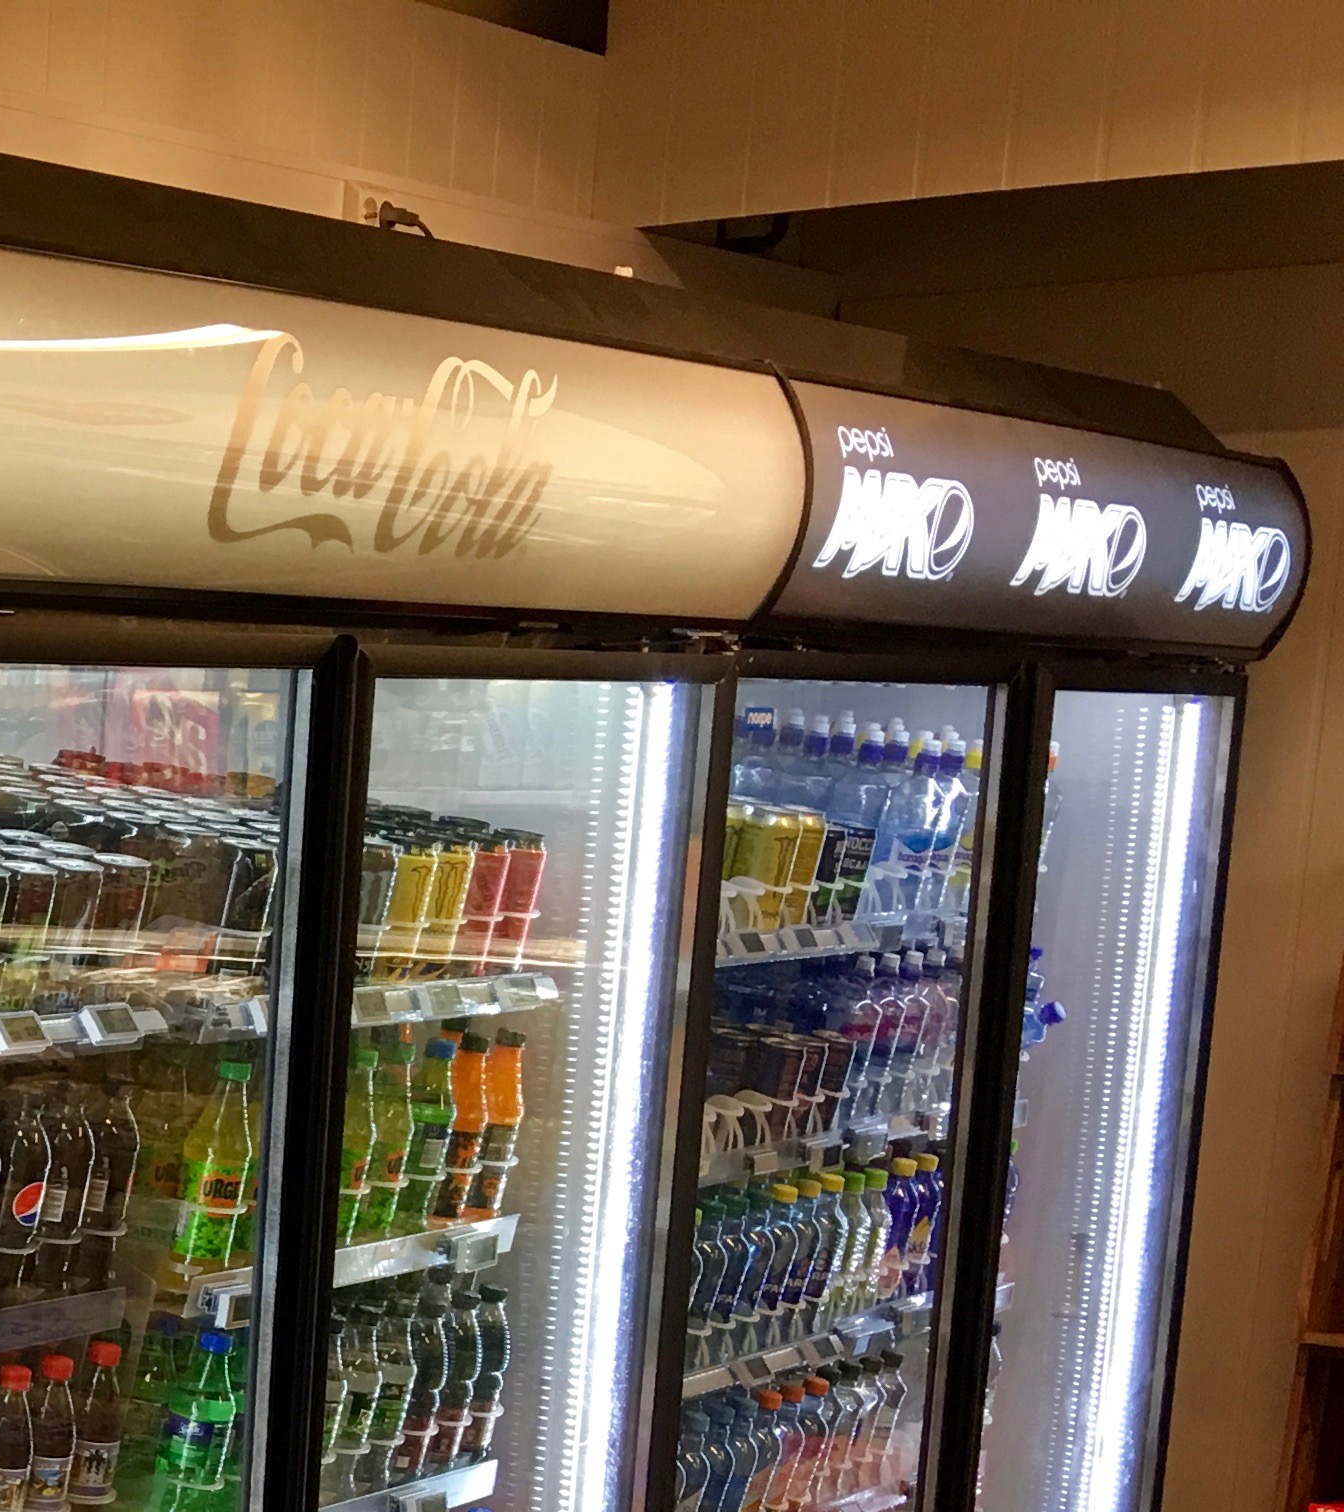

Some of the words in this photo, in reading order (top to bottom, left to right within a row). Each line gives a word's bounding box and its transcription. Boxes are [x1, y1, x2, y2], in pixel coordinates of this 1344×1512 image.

[208, 330, 557, 559] Coca-Cola
[837, 425, 894, 461] pepsi
[1034, 456, 1081, 487] pepsi
[1195, 482, 1236, 513] pepsi
